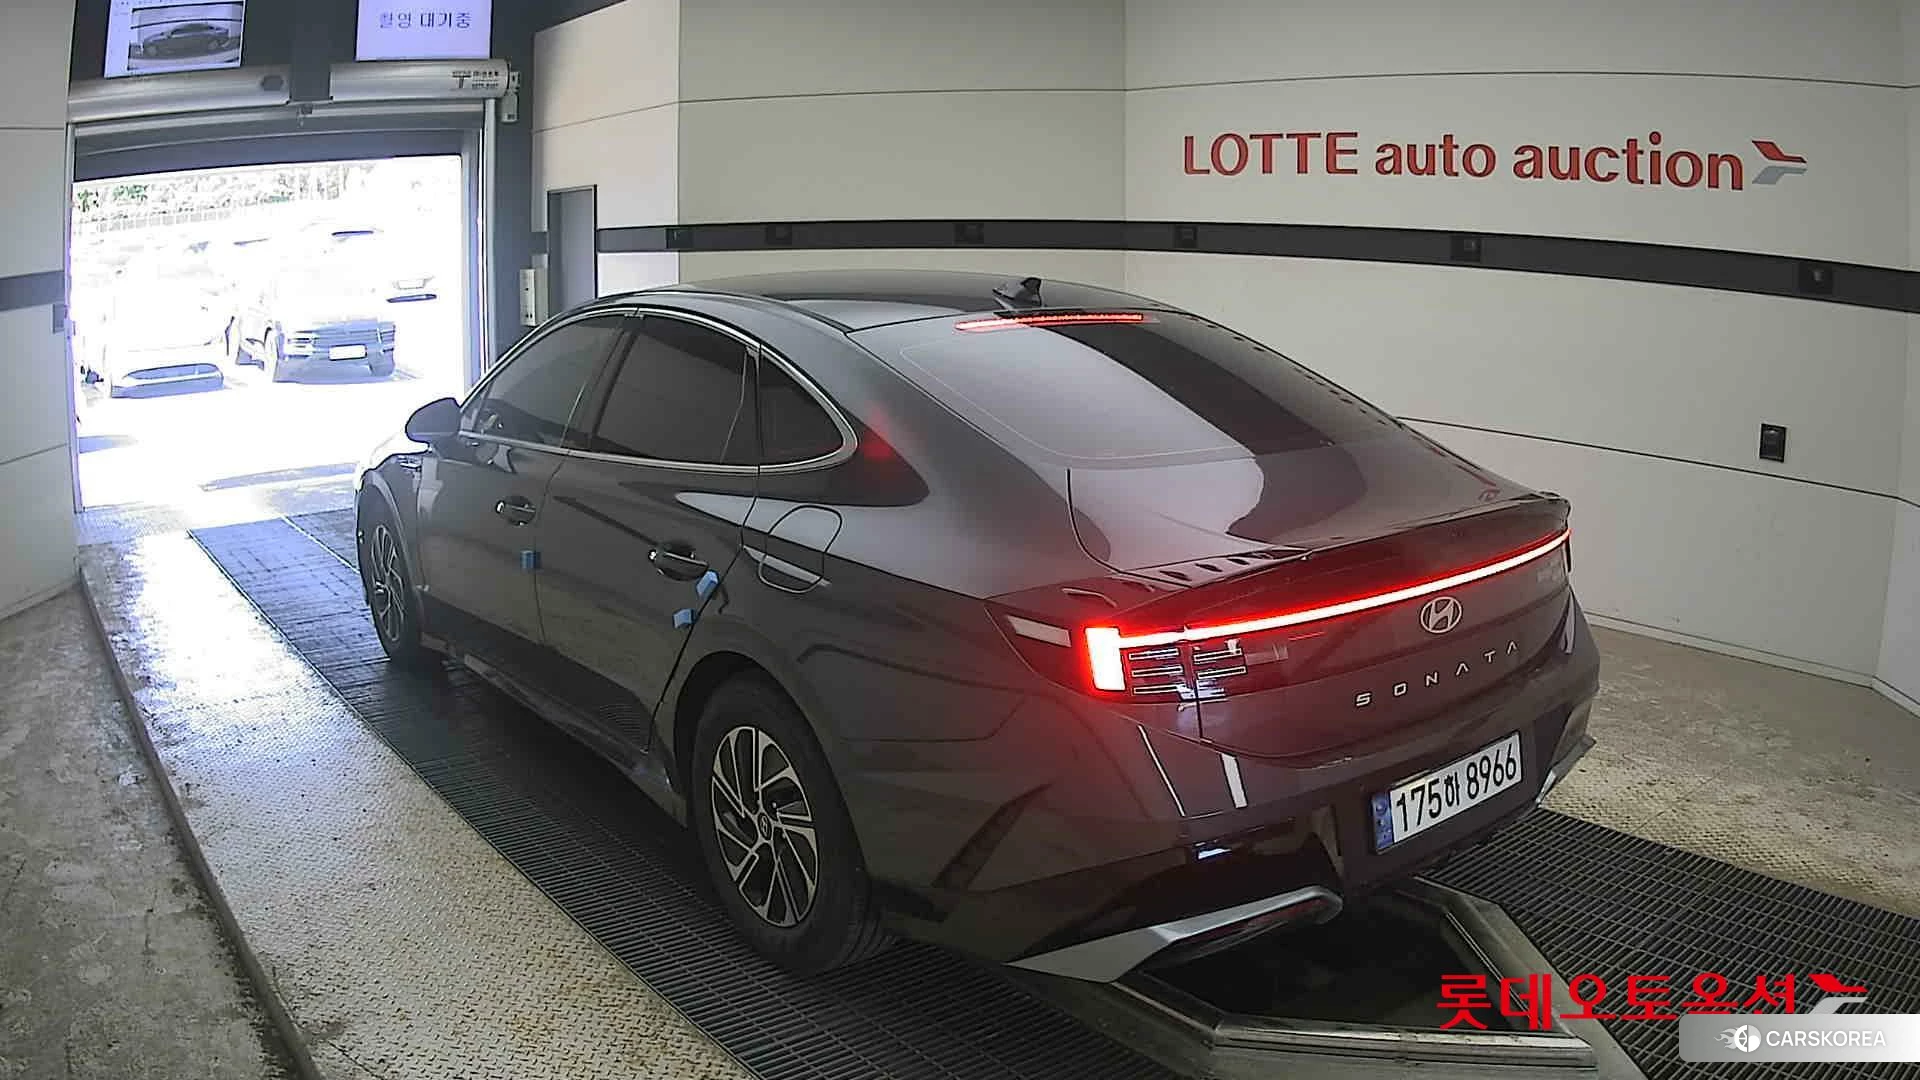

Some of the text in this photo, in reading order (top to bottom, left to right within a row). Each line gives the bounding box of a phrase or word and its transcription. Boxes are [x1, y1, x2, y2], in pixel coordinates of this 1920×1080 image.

[419, 11, 473, 29] 대기중
[1184, 131, 1743, 191] LOTTE auto auction
[1355, 640, 1518, 707] SONATA
[1396, 743, 1517, 832] 175하 8966
